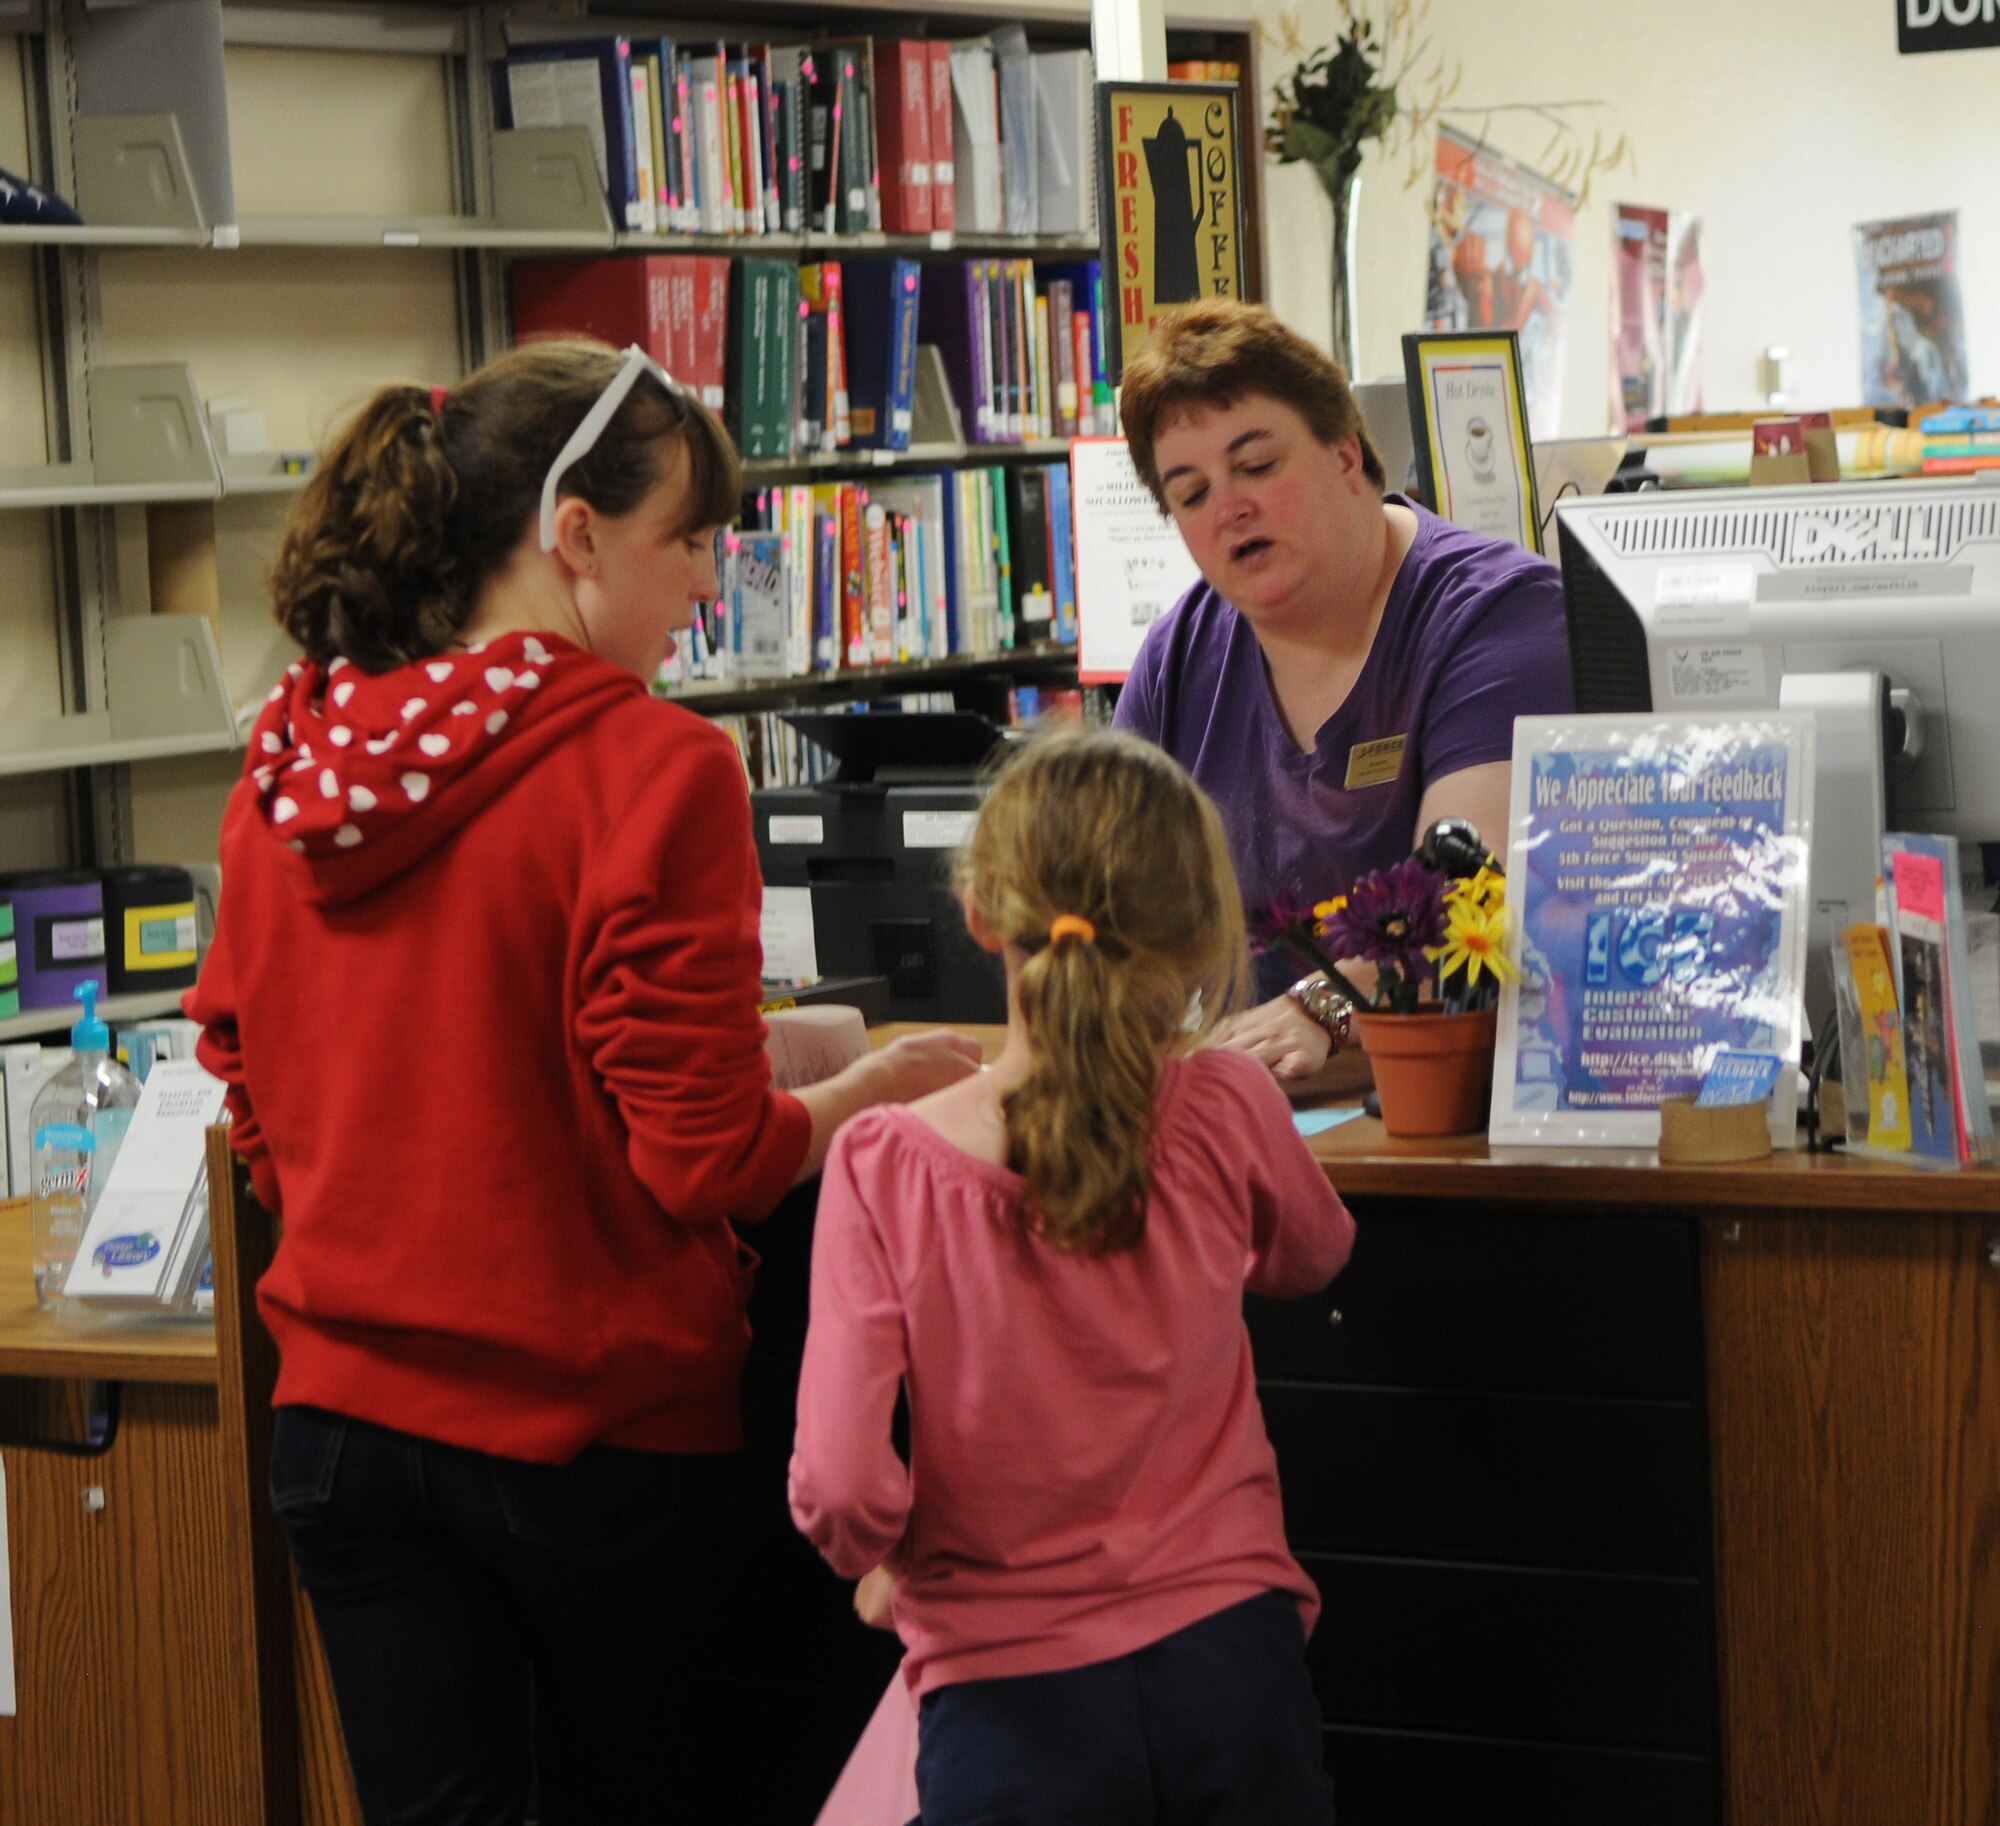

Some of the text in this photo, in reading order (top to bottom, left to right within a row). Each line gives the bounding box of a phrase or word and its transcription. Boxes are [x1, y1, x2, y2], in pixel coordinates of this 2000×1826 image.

[1205, 101, 1230, 295] COFF
[1118, 105, 1144, 325] FRESH
[1792, 509, 1937, 557] DELL
[1536, 774, 1561, 807] We
[1565, 773, 1656, 812] Appreciate
[1703, 767, 1783, 801] Feedback
[1560, 819, 1582, 833] Got
[1586, 821, 1595, 832] a
[1599, 818, 1665, 833] Question,
[1592, 833, 1719, 851] Suggestion for the
[1558, 851, 1580, 866] 5th
[1584, 851, 1621, 865] Force
[1557, 875, 1586, 890] Visit
[1594, 890, 1620, 905] and
[1584, 989, 1696, 1006] Interacti
[1583, 1007, 1691, 1023] Customer
[1582, 1024, 1702, 1041] Evaluation
